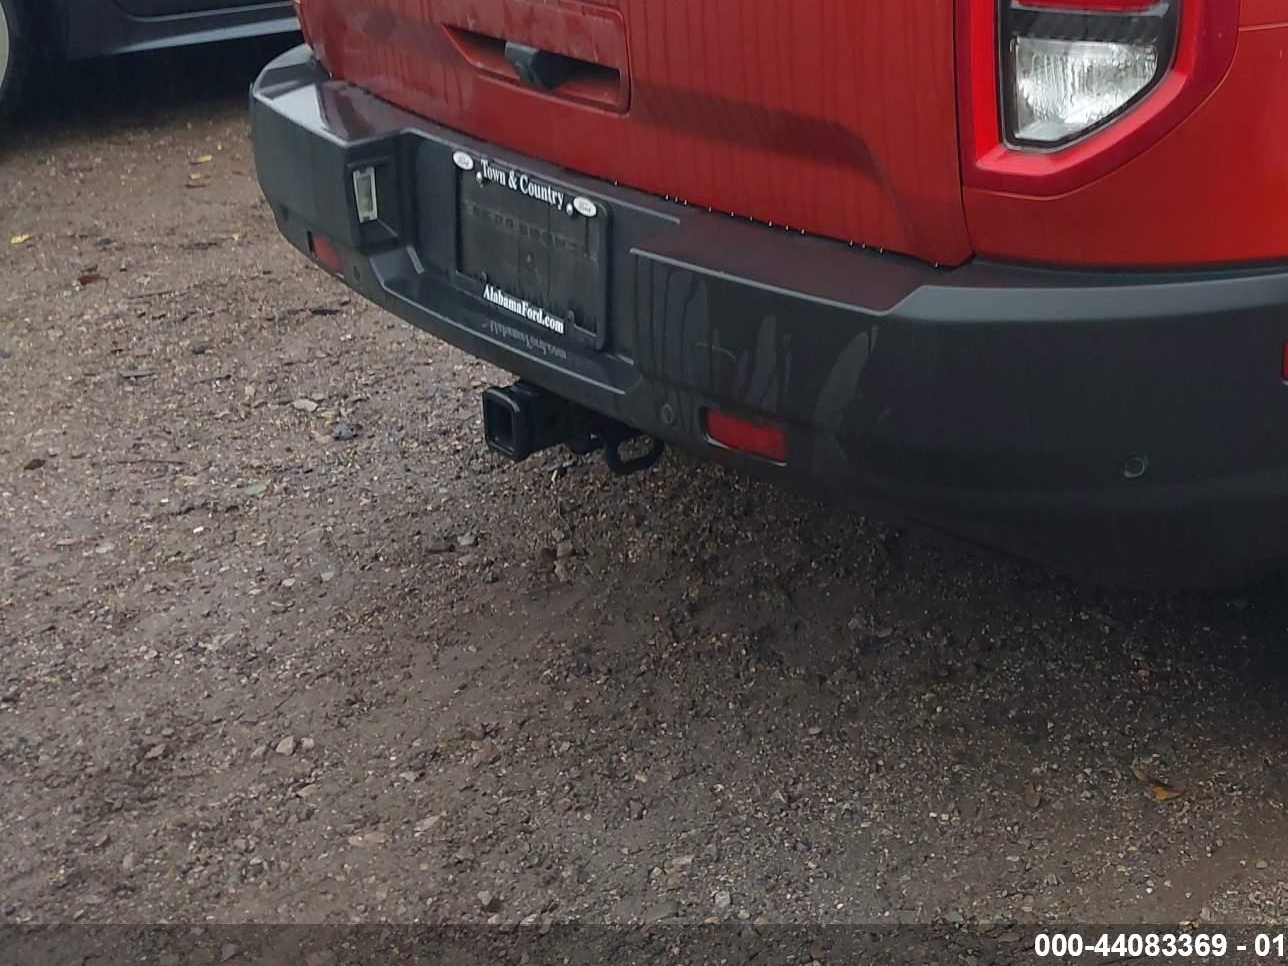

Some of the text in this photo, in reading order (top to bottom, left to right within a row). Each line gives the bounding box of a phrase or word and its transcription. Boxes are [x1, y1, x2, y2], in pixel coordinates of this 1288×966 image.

[480, 158, 506, 186] Town
[508, 169, 518, 190] &
[519, 174, 564, 210] Country
[483, 283, 564, 334] AlabamaFord.com
